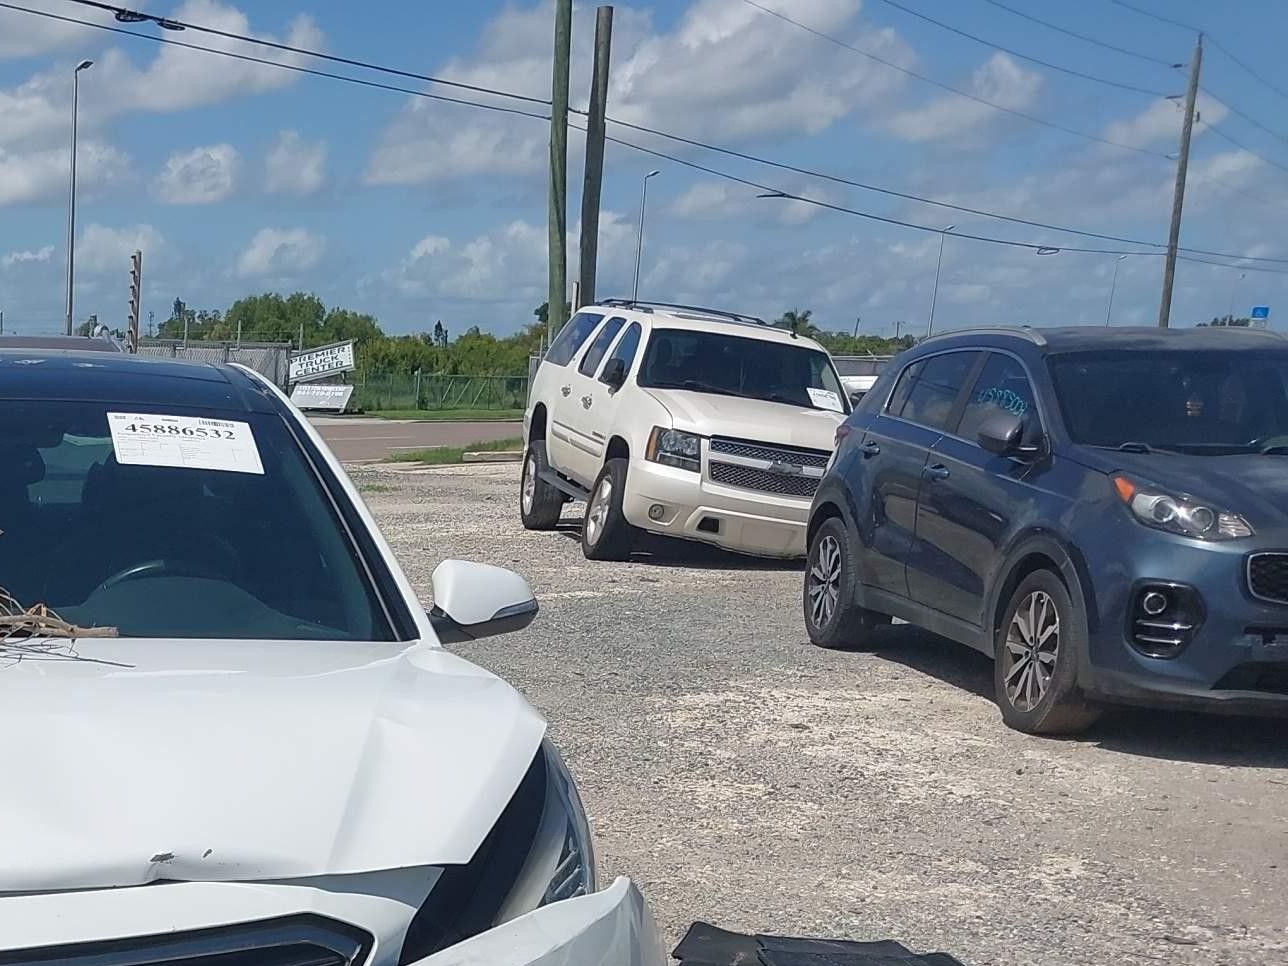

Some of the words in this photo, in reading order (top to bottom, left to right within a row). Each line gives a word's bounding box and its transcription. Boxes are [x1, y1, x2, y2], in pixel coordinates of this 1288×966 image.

[295, 360, 344, 376] CENTER
[298, 354, 340, 369] TRUCK
[124, 423, 236, 441] 45886532
